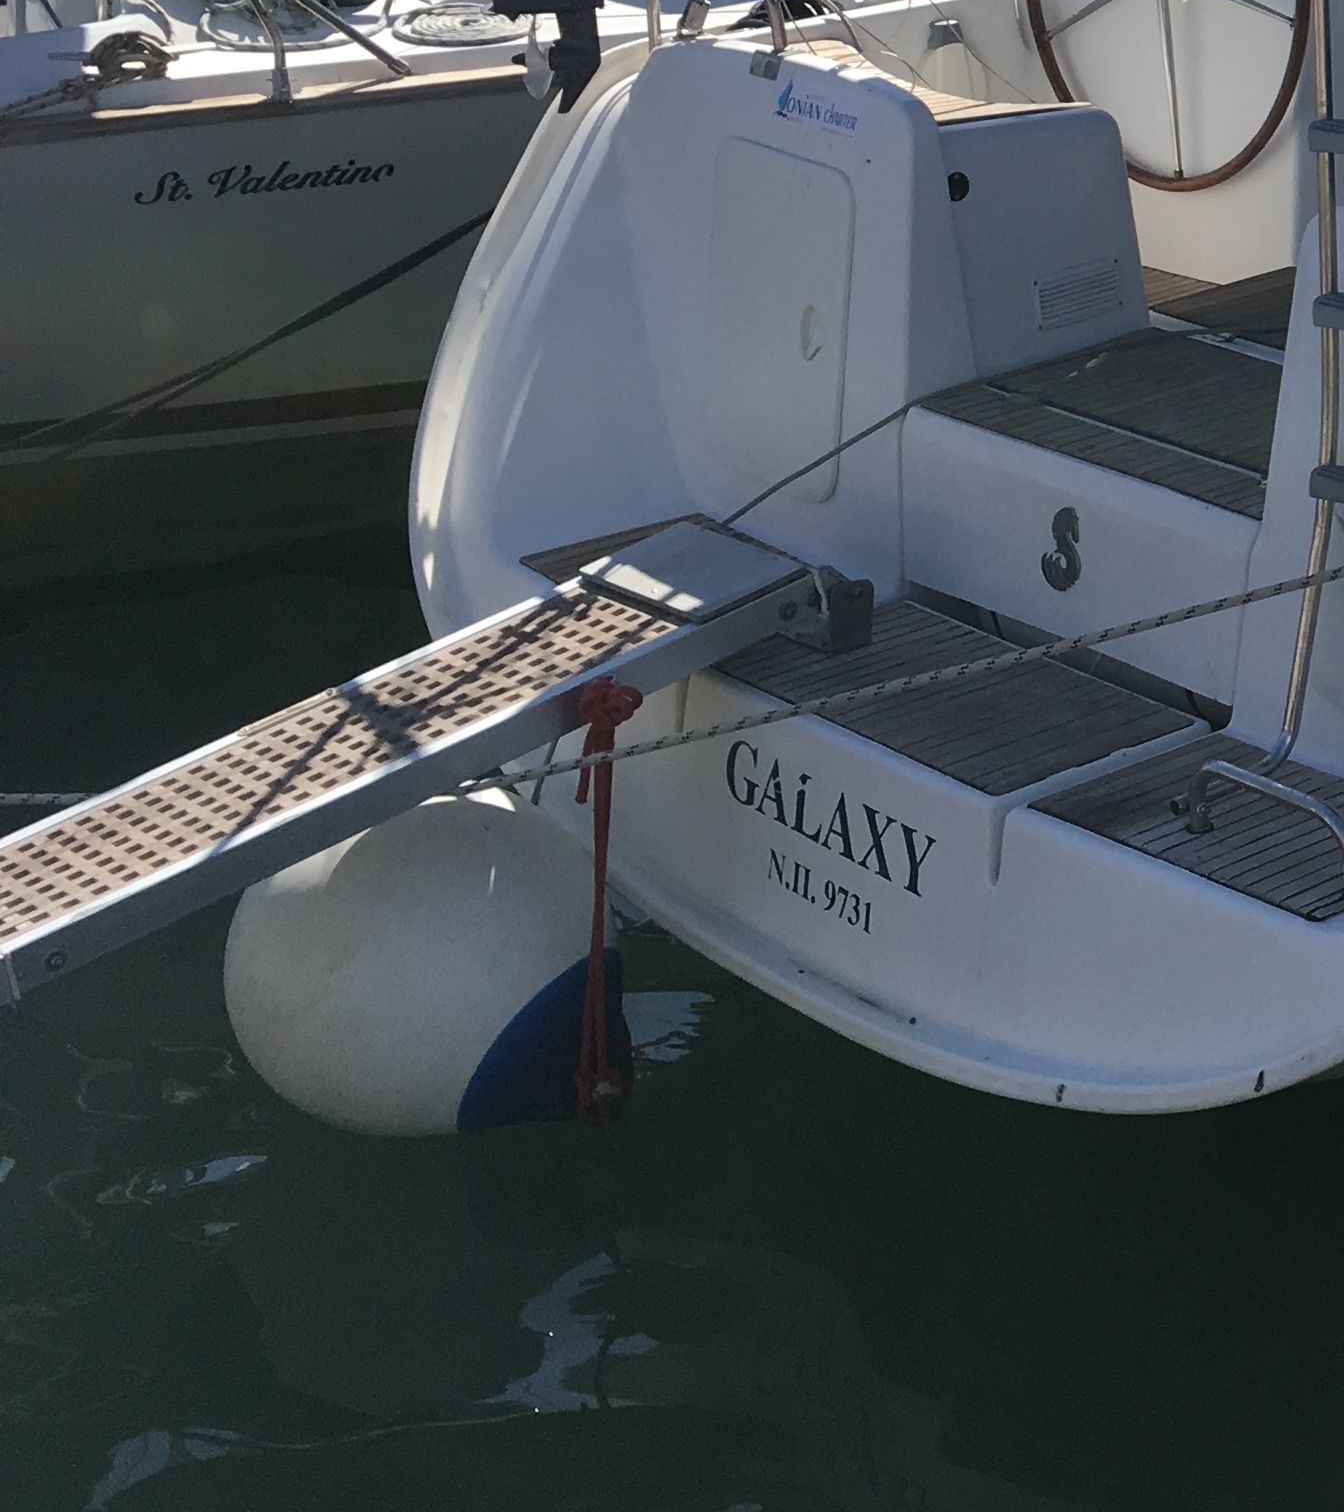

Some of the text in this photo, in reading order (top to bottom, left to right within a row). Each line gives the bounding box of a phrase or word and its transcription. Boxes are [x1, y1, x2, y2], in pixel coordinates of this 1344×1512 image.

[134, 159, 396, 206] St. Valentino
[725, 739, 937, 897] GALAXY
[823, 880, 872, 935] 9731
